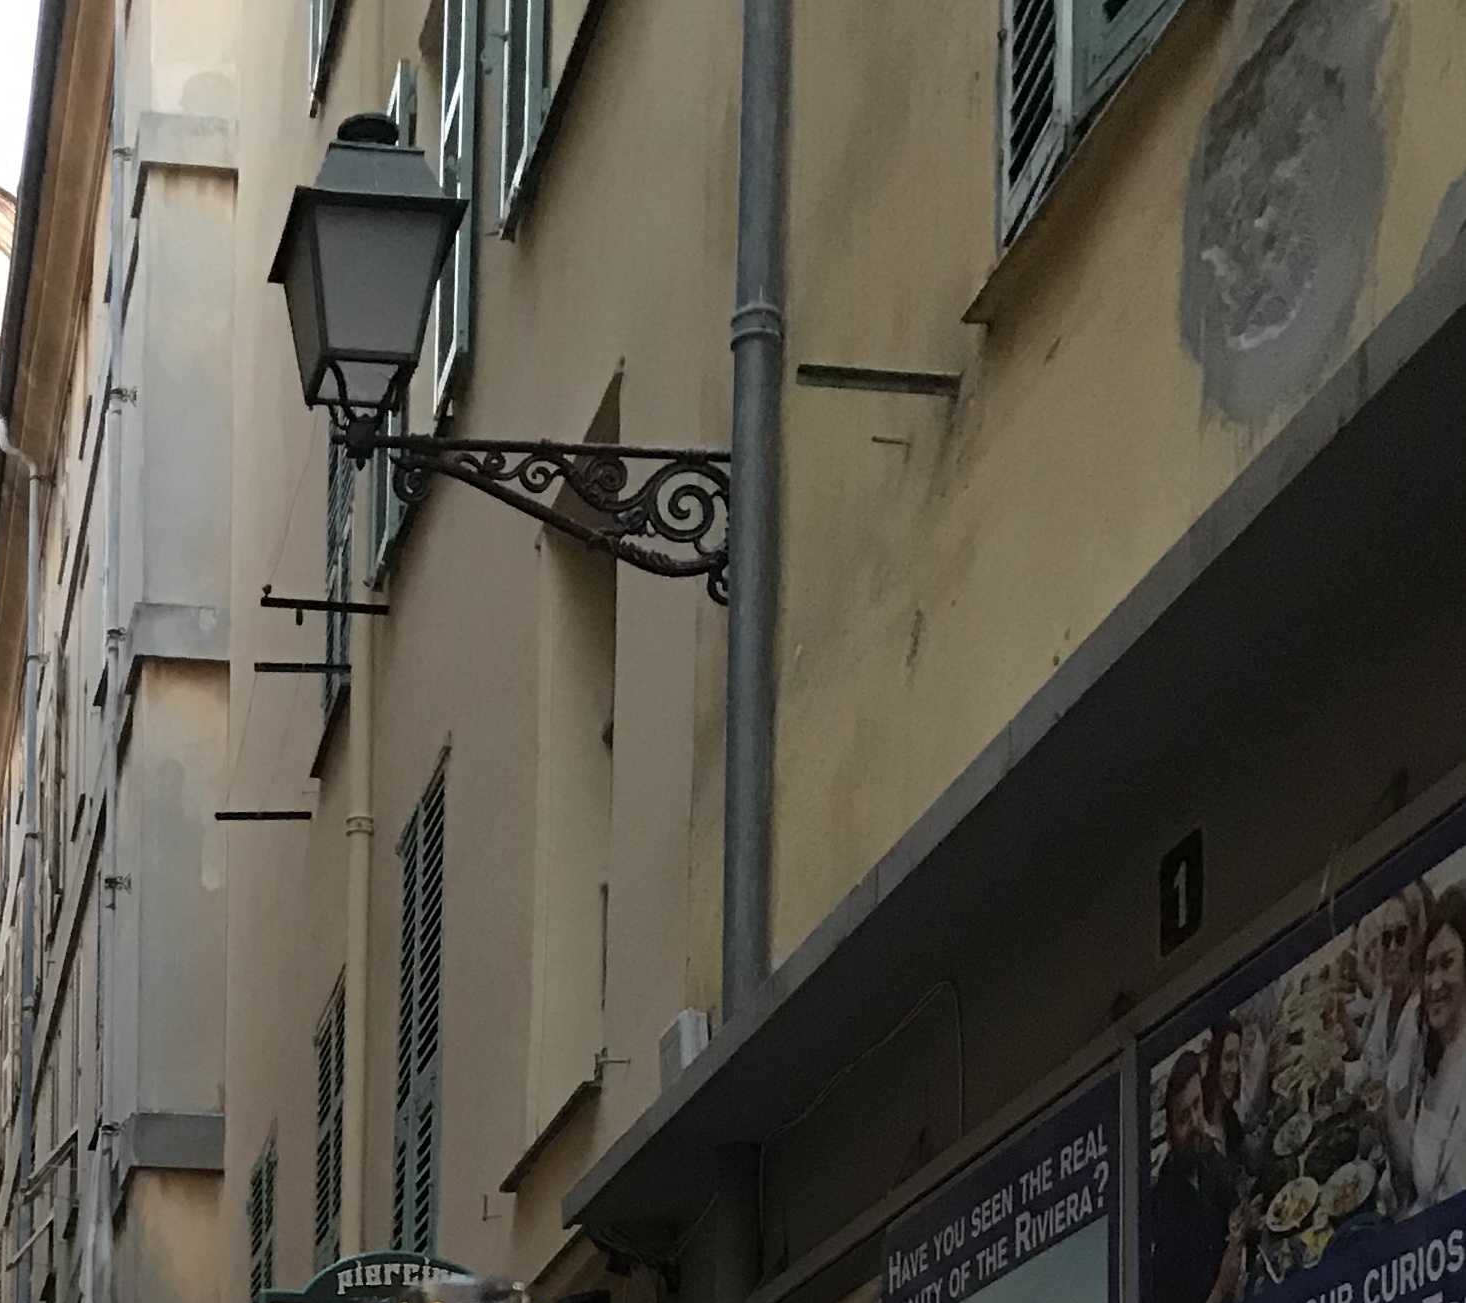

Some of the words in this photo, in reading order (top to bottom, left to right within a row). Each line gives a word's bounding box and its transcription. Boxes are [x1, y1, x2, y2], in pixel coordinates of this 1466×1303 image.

[1172, 860, 1187, 928] 1
[888, 1242, 928, 1294] HAVE
[934, 1216, 966, 1261] YOU
[971, 1185, 1014, 1238] SEEN
[1019, 1158, 1053, 1204] THE
[1060, 1124, 1108, 1180] REAL
[949, 1260, 971, 1298] OF
[976, 1236, 1009, 1281] THE
[1015, 1160, 1110, 1258] RIVIERA?
